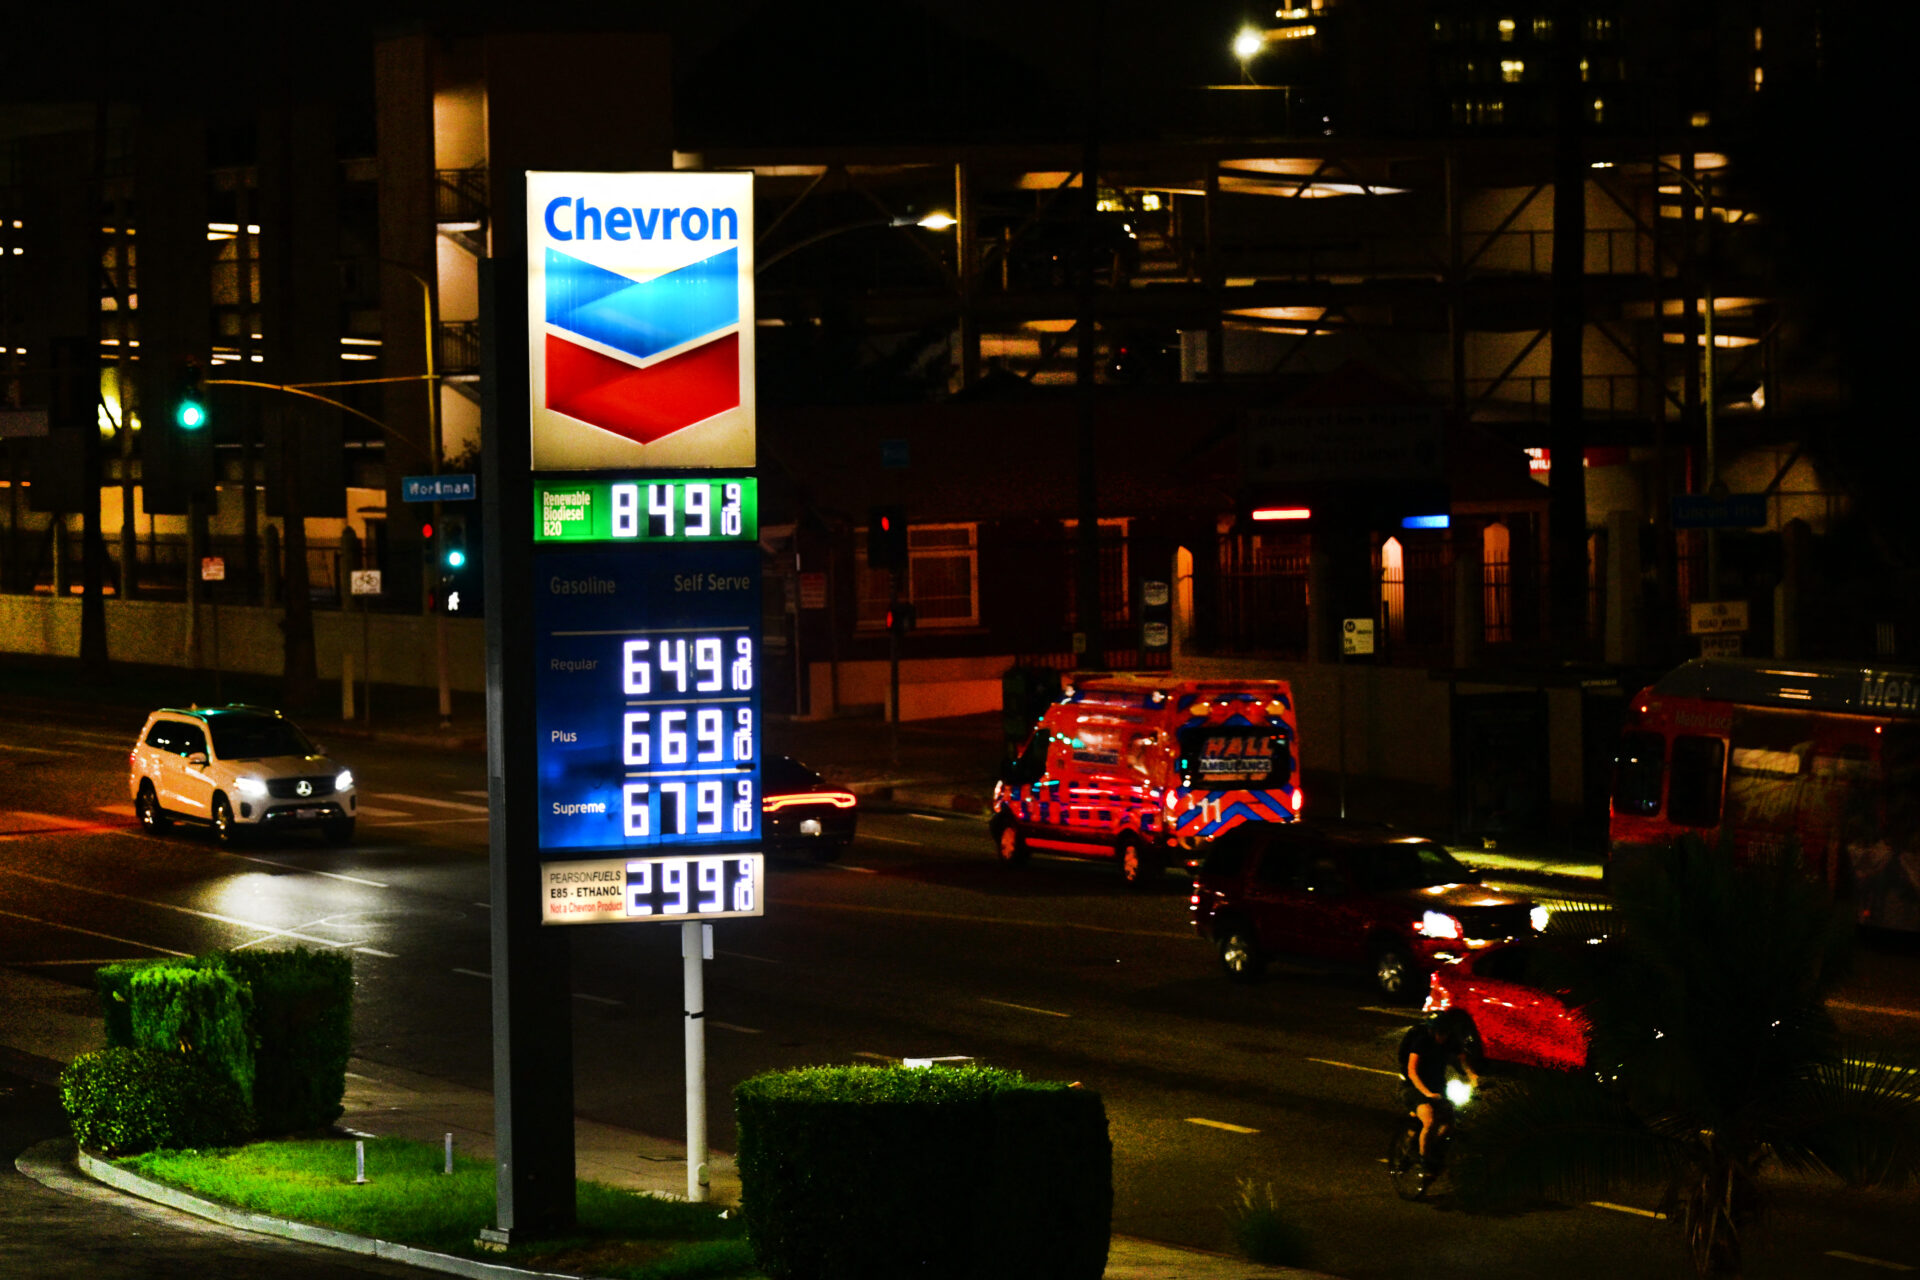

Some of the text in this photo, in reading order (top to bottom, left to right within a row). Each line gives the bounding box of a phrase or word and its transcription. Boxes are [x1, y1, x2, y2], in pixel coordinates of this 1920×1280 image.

[544, 197, 738, 242] Chevron
[409, 480, 471, 497] Workman
[543, 491, 591, 506] Renewable
[543, 506, 584, 521] Biodiesel
[611, 484, 711, 537] 849
[543, 521, 562, 536] B20
[551, 576, 616, 594] Gasoline
[674, 573, 750, 592] Self Serve
[1703, 638, 1738, 649] SPEED
[551, 658, 598, 672] Regular
[623, 637, 723, 695] 649
[551, 731, 577, 743] Plus
[623, 709, 723, 765] 669
[1203, 736, 1273, 757] HALL
[1200, 760, 1271, 772] AMBULANCE
[552, 802, 606, 816] Supreme
[623, 781, 722, 837] 679
[550, 870, 621, 883] PEARSONFUELS
[550, 888, 569, 899] E85
[576, 885, 622, 898] ETHANOL
[626, 859, 724, 916] 299
[550, 903, 562, 914] Not
[568, 902, 596, 912] Chevron
[597, 901, 623, 912] Product
